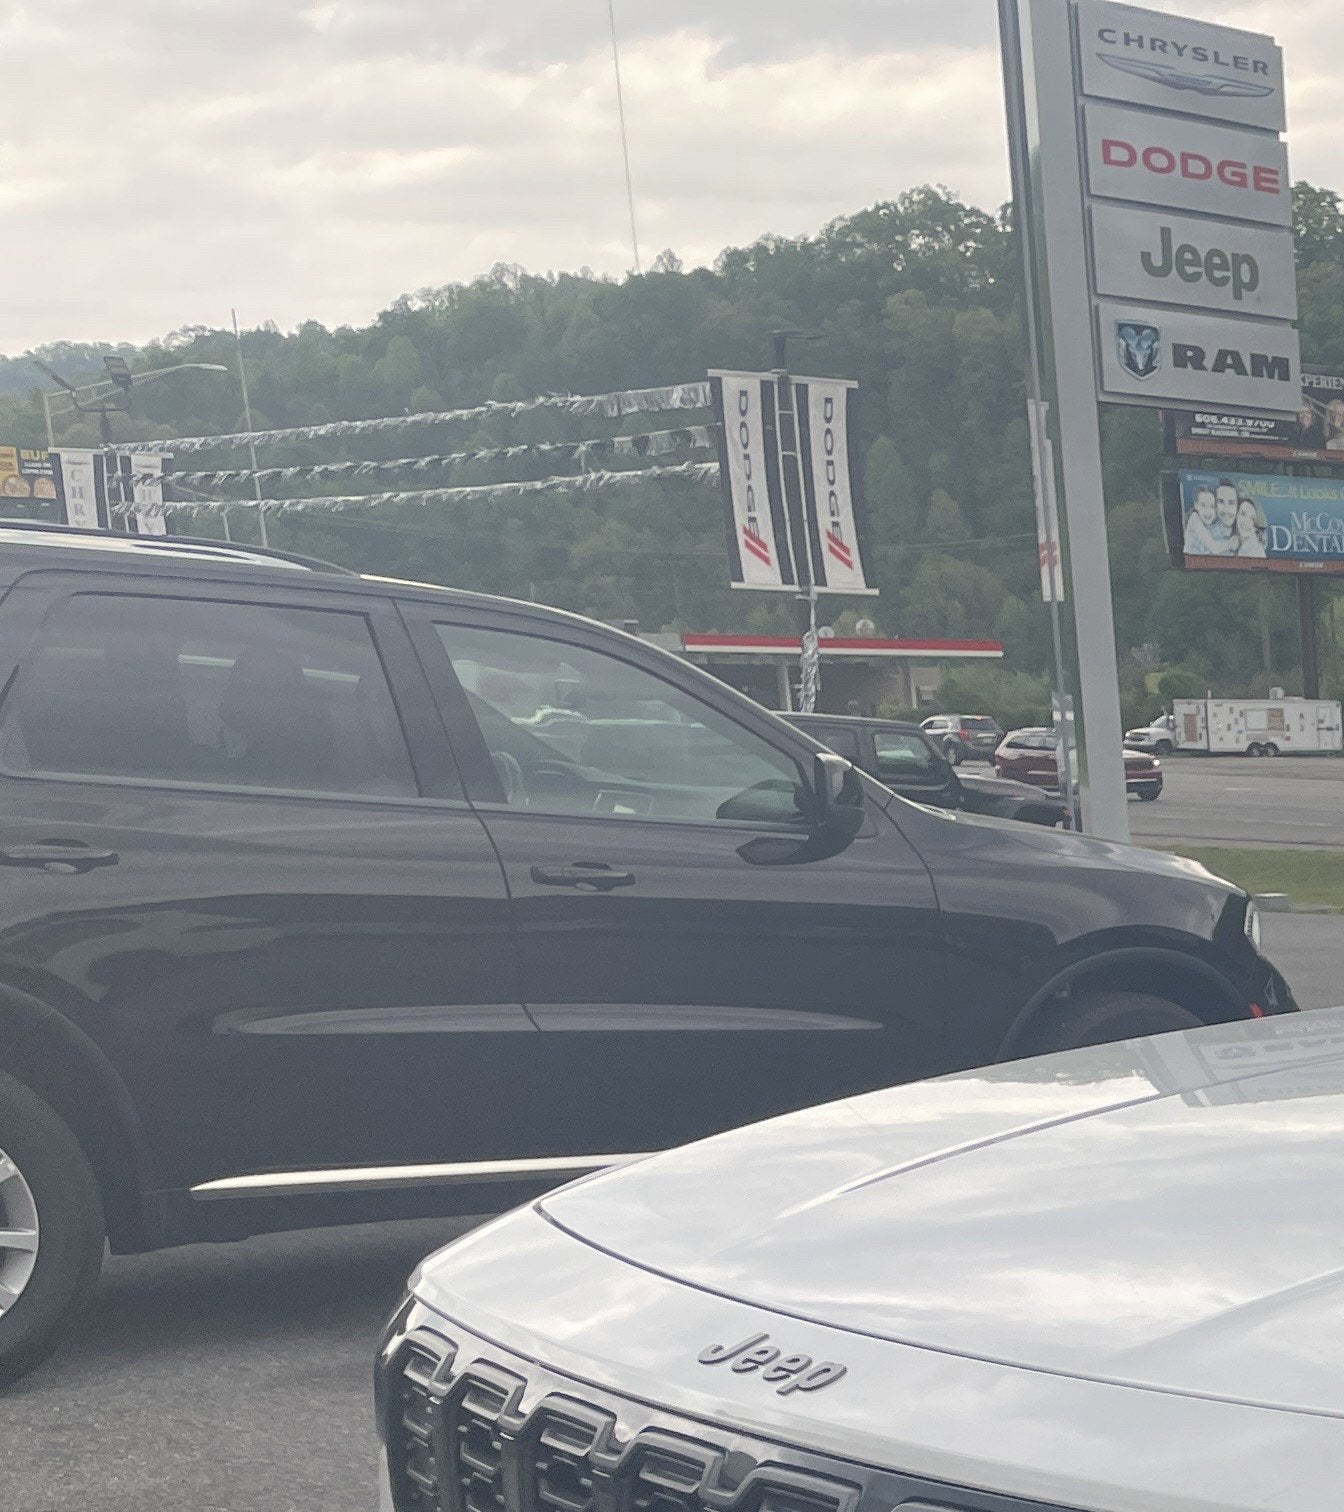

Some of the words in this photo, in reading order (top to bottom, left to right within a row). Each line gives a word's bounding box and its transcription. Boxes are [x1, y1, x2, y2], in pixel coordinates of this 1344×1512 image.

[1097, 28, 1270, 76] CHRYSLER
[1101, 138, 1280, 194] DODGE
[1140, 226, 1259, 300] Jeep
[1172, 343, 1291, 382] RAM
[738, 389, 760, 540] DODGE
[824, 397, 844, 545] DODGE
[697, 1332, 848, 1396] Jeep
